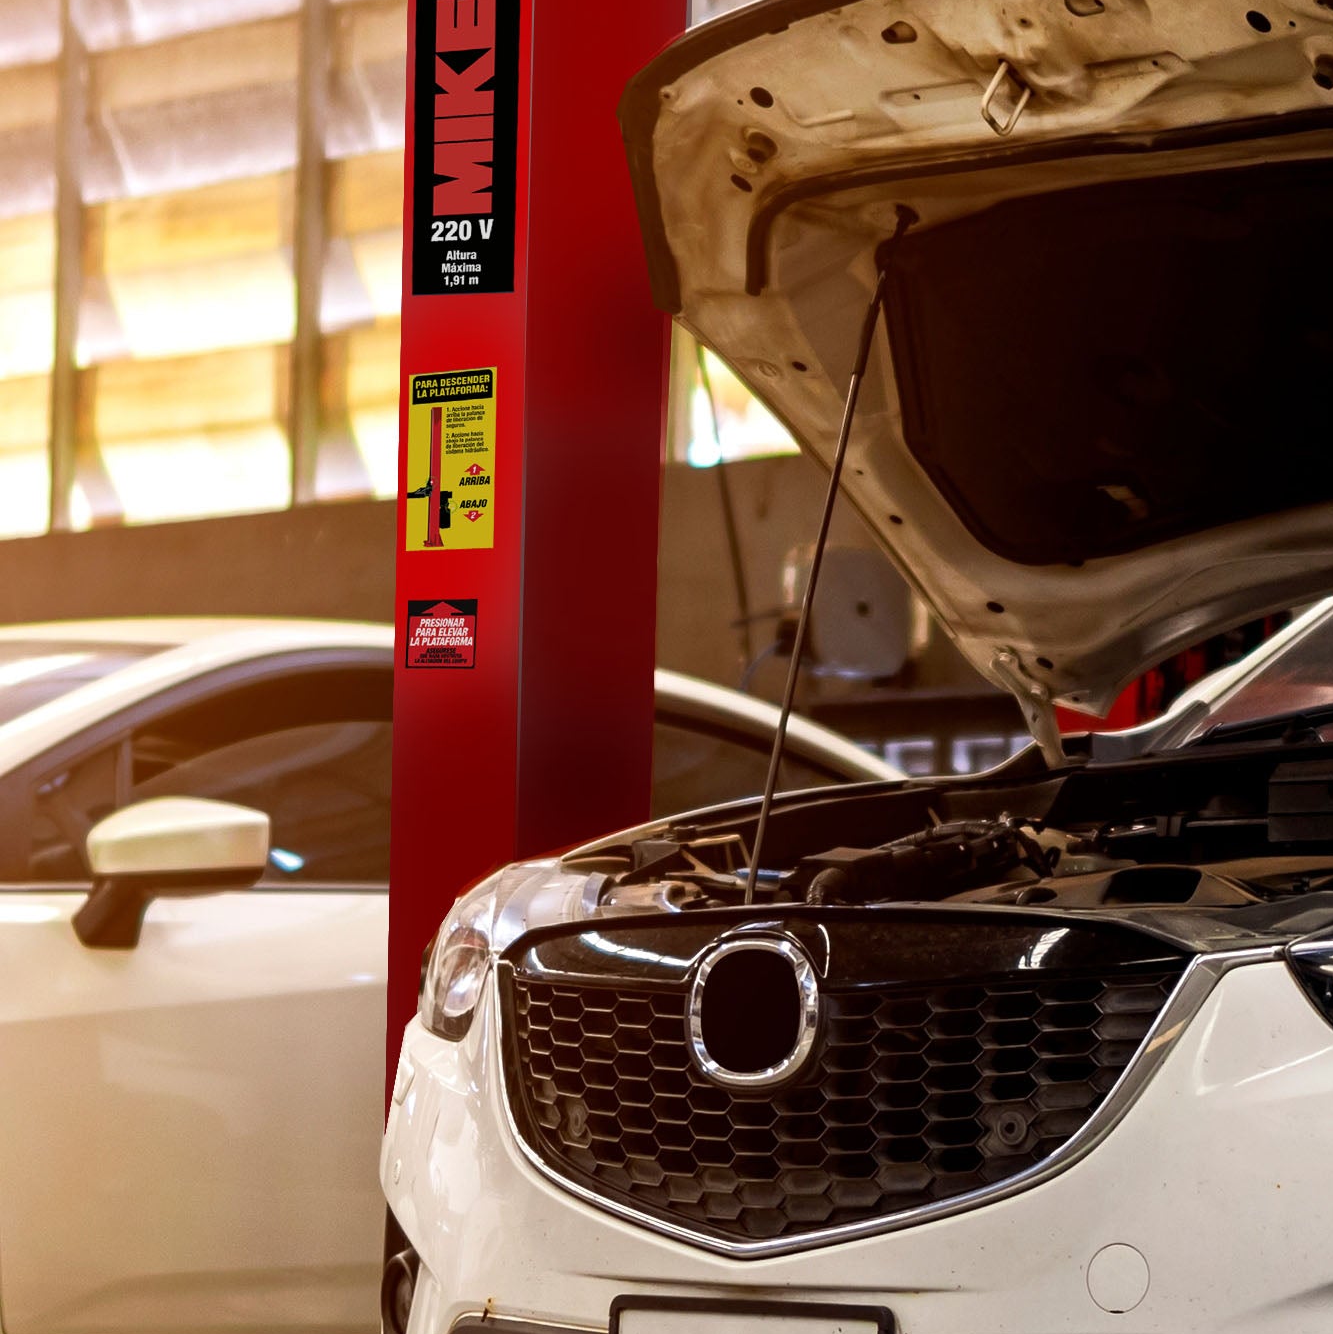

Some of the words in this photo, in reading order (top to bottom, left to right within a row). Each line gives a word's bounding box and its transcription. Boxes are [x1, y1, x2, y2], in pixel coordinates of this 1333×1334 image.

[431, 220, 472, 242] 220
[478, 218, 494, 240] V
[446, 250, 477, 261] Altura
[441, 262, 481, 273] Máxima
[444, 275, 465, 287] 1,91
[469, 276, 479, 285] m
[415, 379, 438, 389] PARA
[440, 374, 490, 387] DESCENDER
[417, 389, 427, 398] LA
[430, 384, 488, 397] PLATAFORMA:
[473, 466, 477, 474] 1
[459, 475, 490, 487] ARRIBA
[459, 498, 488, 508] ABAJO
[470, 511, 476, 519] 2
[420, 617, 465, 627] PRESIONAR
[415, 627, 436, 637] PARA
[438, 627, 469, 637] ELEVAR
[409, 637, 420, 646] LA
[421, 636, 473, 646] PLATAFORMA
